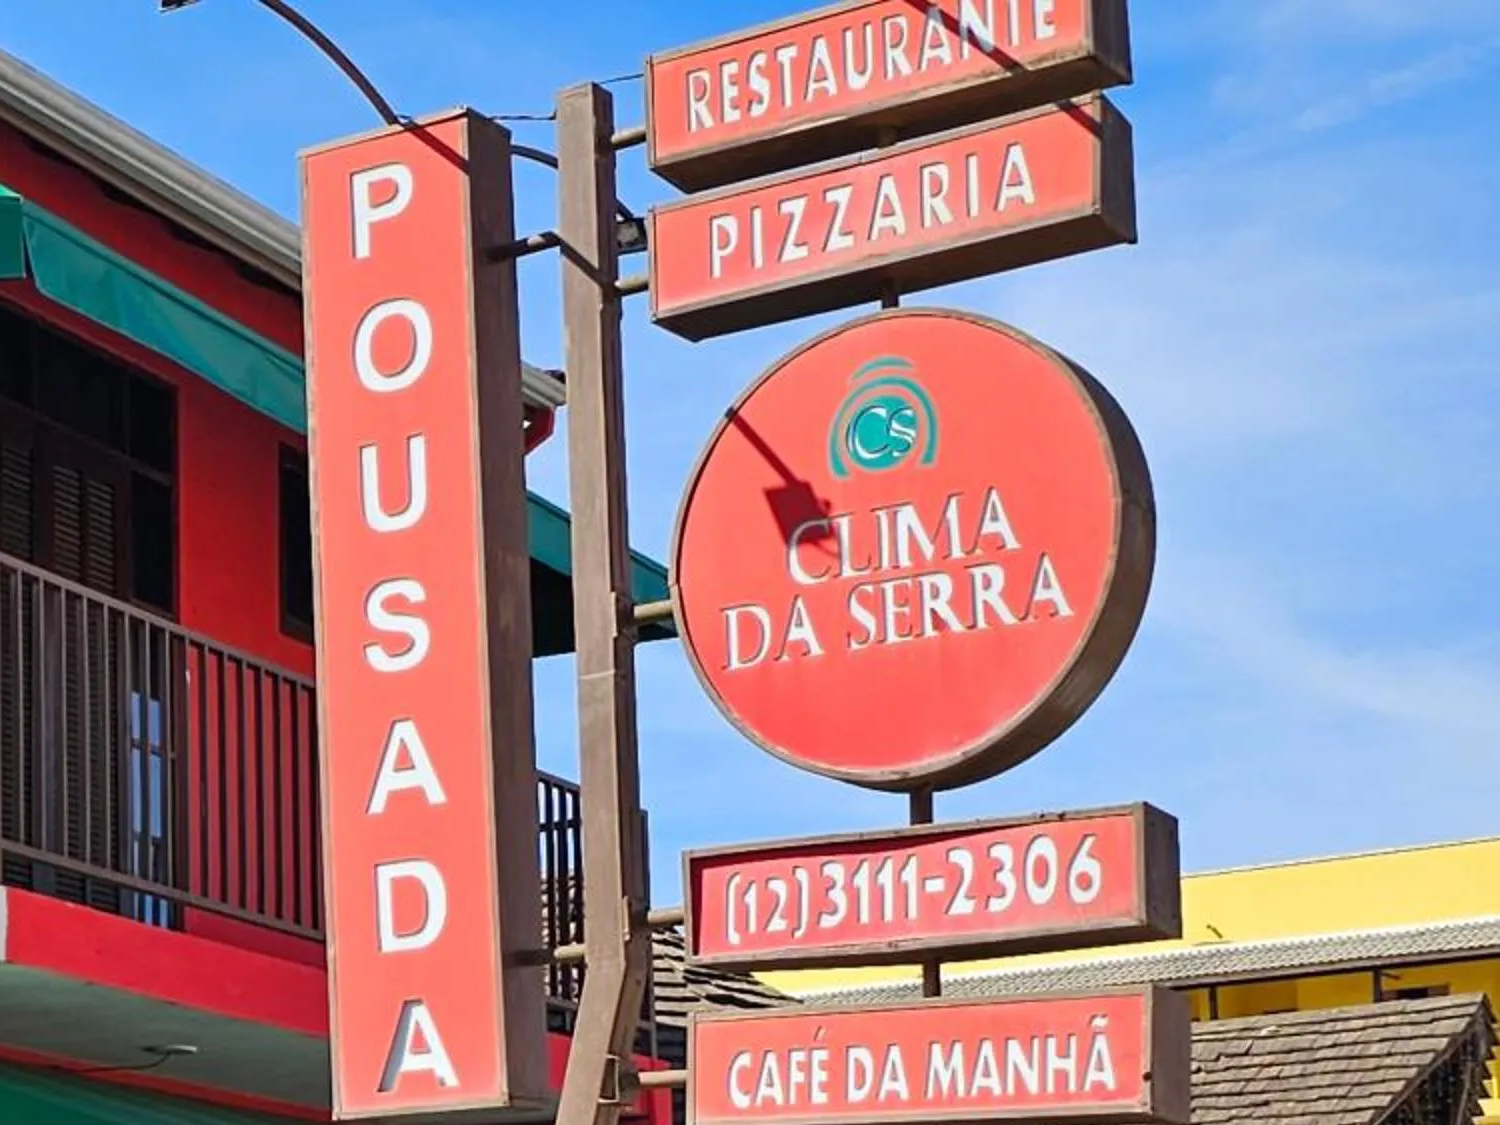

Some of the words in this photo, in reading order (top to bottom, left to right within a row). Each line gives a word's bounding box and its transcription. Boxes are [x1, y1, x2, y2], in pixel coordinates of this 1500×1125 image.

[710, 143, 1036, 278] PIZZARIA
[847, 406, 917, 459] CS
[788, 487, 1020, 586] CLIMA
[350, 160, 460, 1094] POUSADA
[721, 596, 824, 671] DA
[846, 553, 1075, 650] SERRA
[726, 833, 1103, 945] (12)3111-2306
[729, 1027, 831, 1109] CAFÉ
[845, 1043, 910, 1102] DA
[927, 1014, 1118, 1098] MANHÃ
